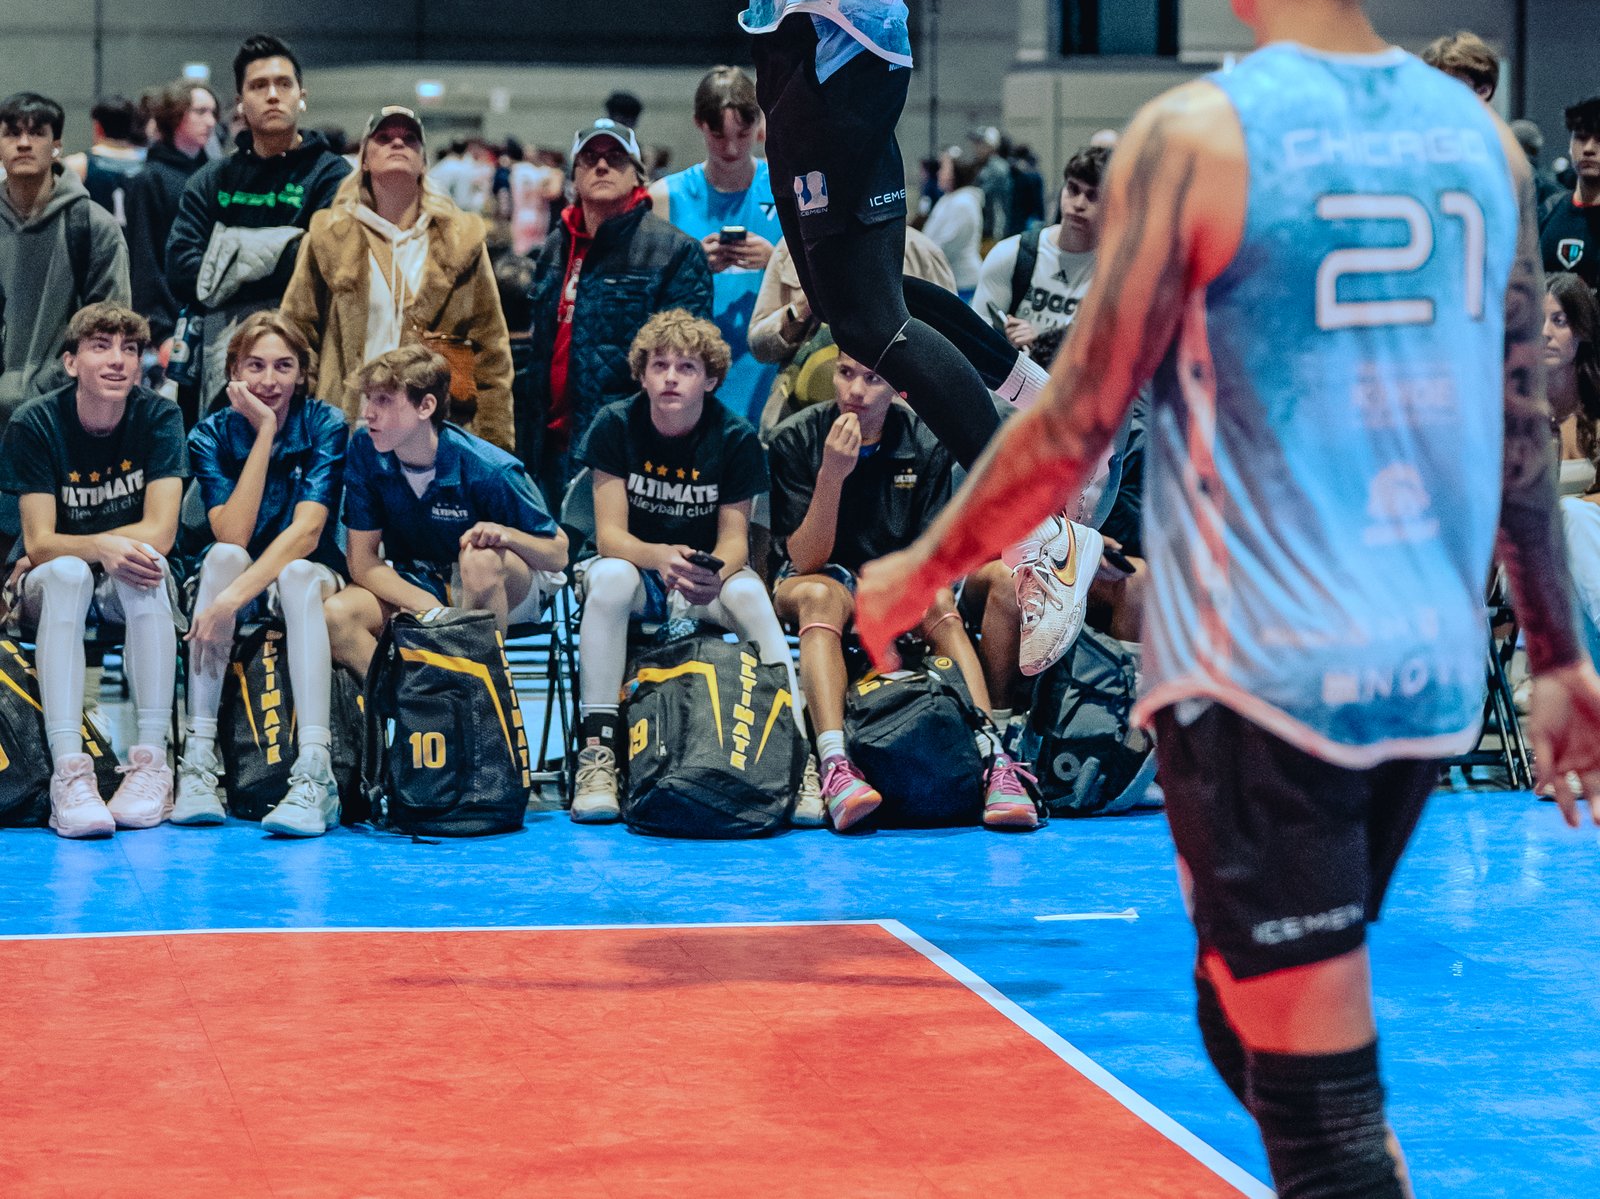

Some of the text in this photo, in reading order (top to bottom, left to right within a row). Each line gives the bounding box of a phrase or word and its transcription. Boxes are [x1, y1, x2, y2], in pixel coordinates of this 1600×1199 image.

[800, 206, 829, 218] CEMEN
[869, 187, 906, 208] ICEME
[1314, 190, 1486, 331] 21
[629, 495, 684, 517] lleyball
[729, 651, 759, 771] ULTIMATE
[408, 731, 446, 769] 10
